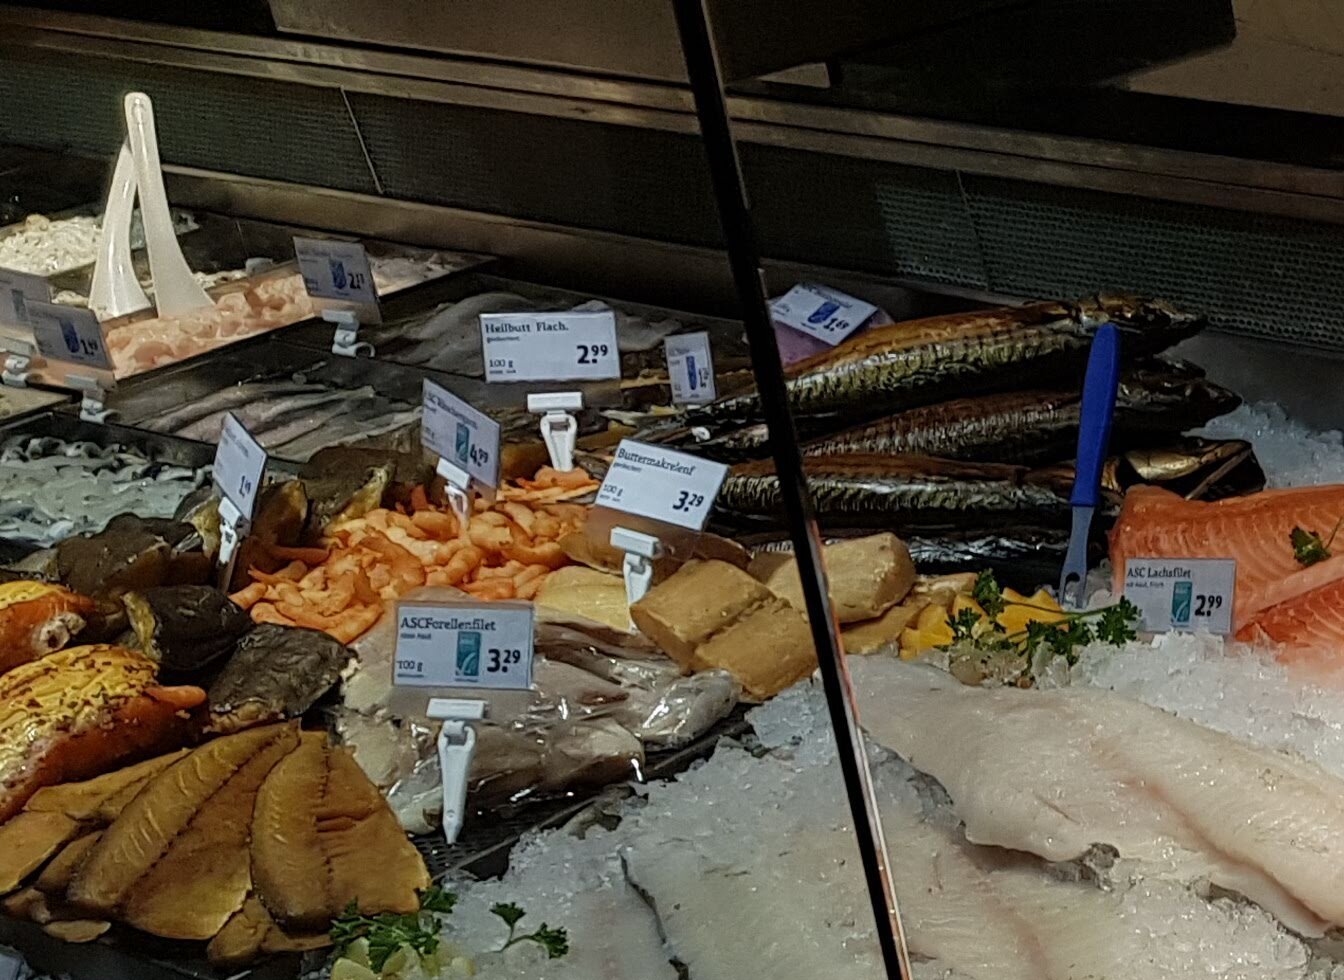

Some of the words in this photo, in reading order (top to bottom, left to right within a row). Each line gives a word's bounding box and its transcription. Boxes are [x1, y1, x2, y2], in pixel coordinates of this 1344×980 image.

[485, 322, 531, 333] Heilbutt
[536, 321, 569, 332] Flach.
[577, 344, 608, 364] 2.99
[489, 359, 505, 367] 100
[672, 491, 704, 512] 3.29
[1128, 567, 1146, 578] ASC
[1147, 567, 1191, 579] Lachsfilet
[1195, 595, 1223, 616] 2.99
[396, 661, 415, 670] 100
[487, 648, 521, 673] 3.29
